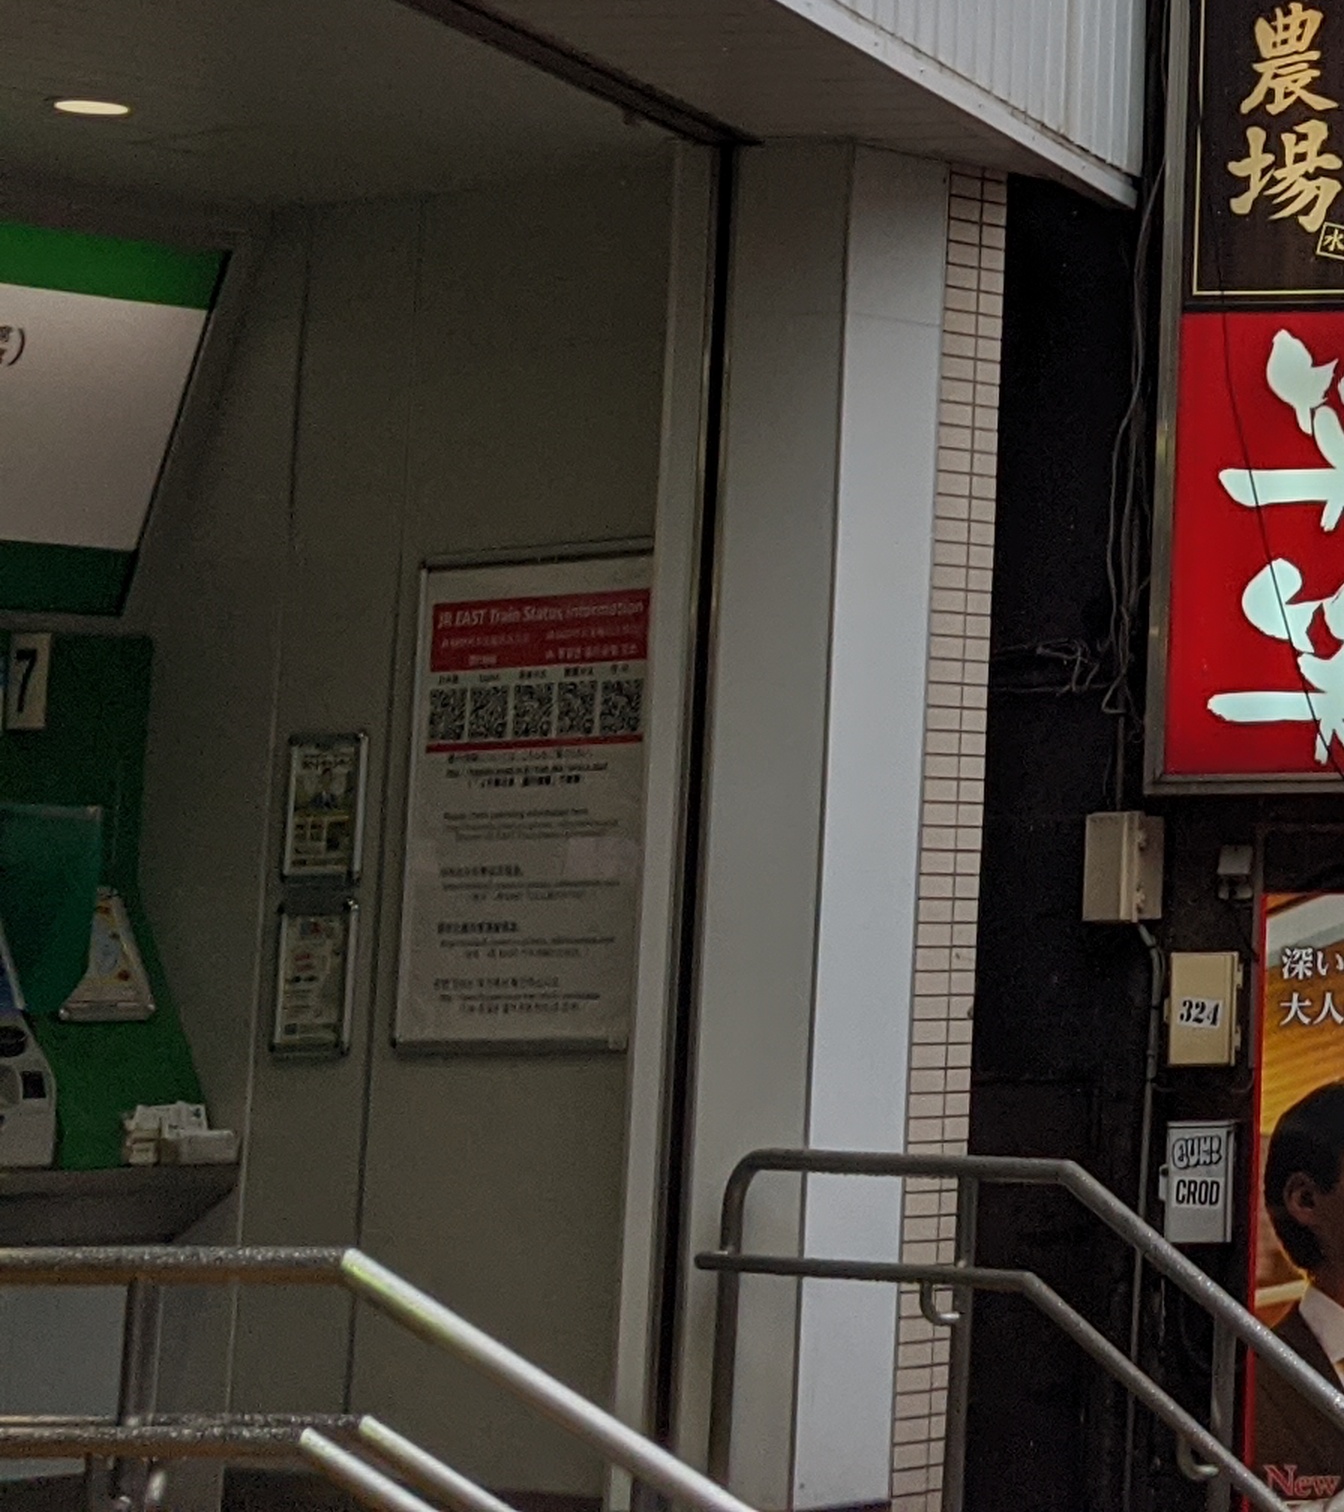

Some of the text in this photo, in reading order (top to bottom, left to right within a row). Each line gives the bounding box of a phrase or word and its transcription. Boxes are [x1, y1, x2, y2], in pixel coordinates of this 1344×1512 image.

[1227, 2, 1344, 233] 農場
[15, 650, 38, 714] 7
[1180, 999, 1220, 1026] 324
[1176, 1179, 1220, 1205] CROD
[1264, 1465, 1341, 1497] New
